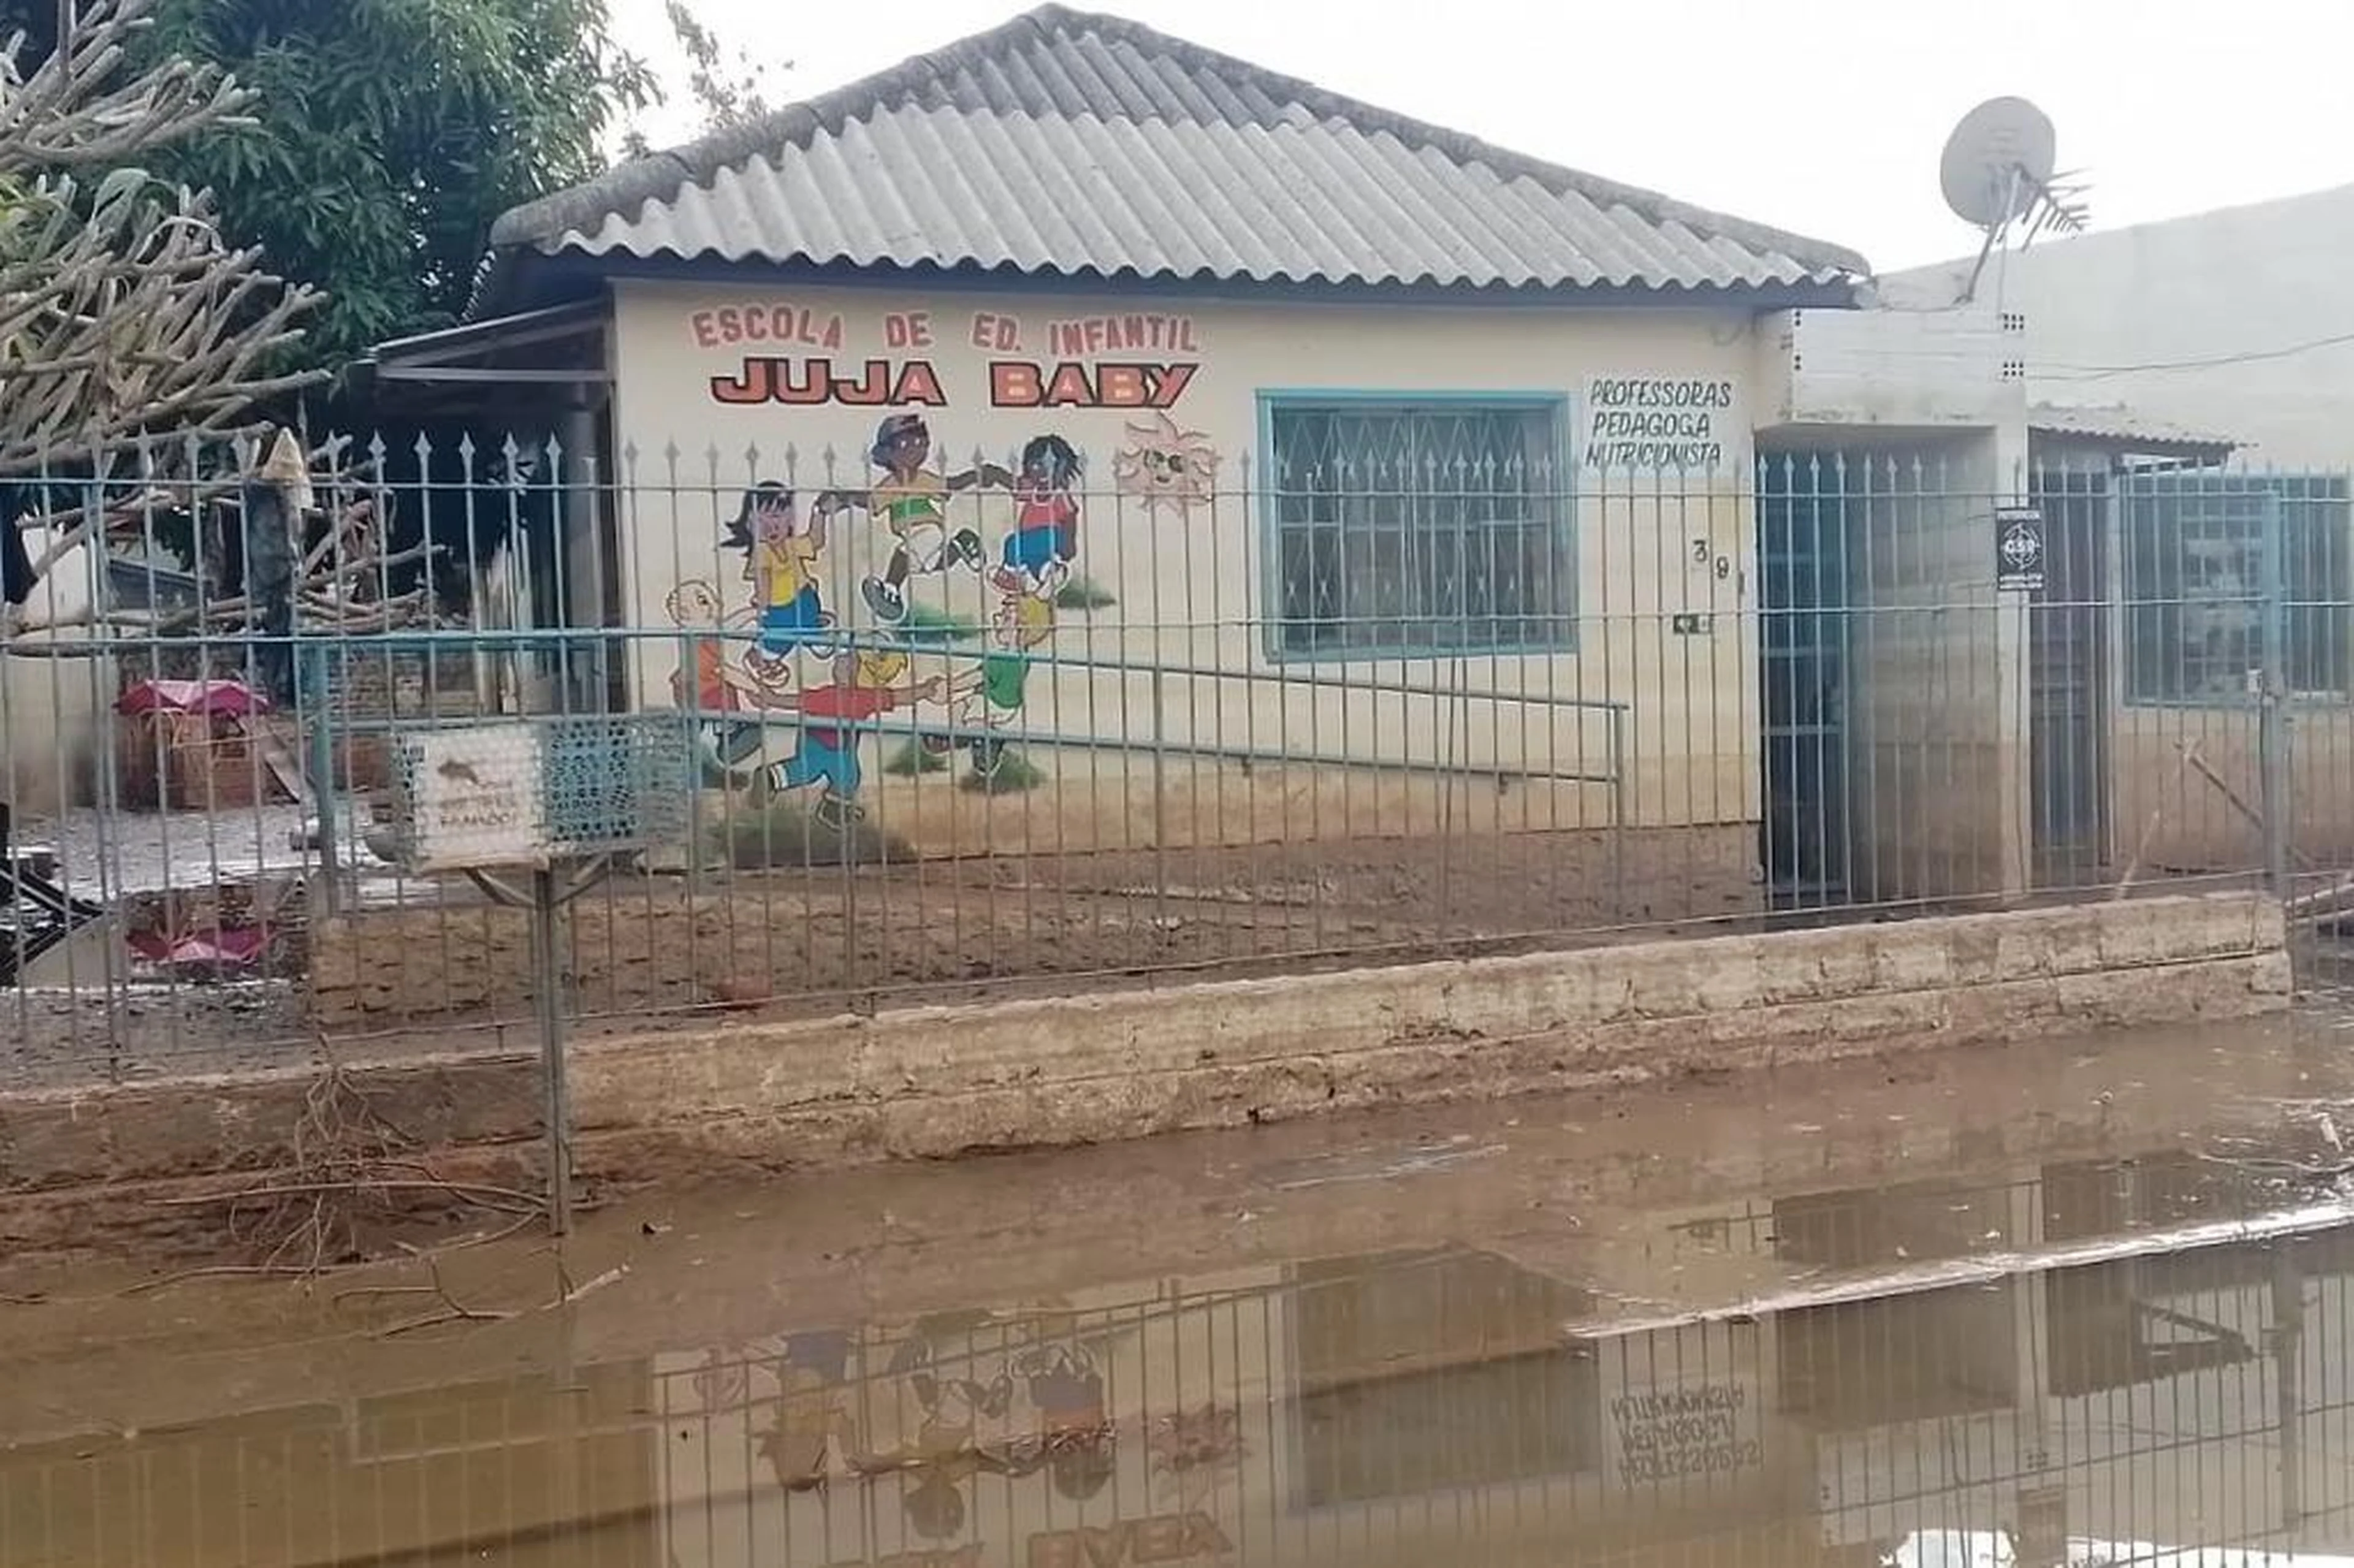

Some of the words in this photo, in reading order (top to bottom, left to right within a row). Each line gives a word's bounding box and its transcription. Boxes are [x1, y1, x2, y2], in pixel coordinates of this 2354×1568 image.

[693, 307, 842, 349] ESCOLA
[885, 313, 932, 347] DE
[973, 314, 1022, 351] ED.
[1049, 313, 1197, 354] INFANTIL
[711, 357, 947, 406] JUJA
[989, 362, 1199, 407] BABY
[1590, 379, 1731, 407] PROFESSORAS
[1593, 411, 1710, 438] PEDAGOGA
